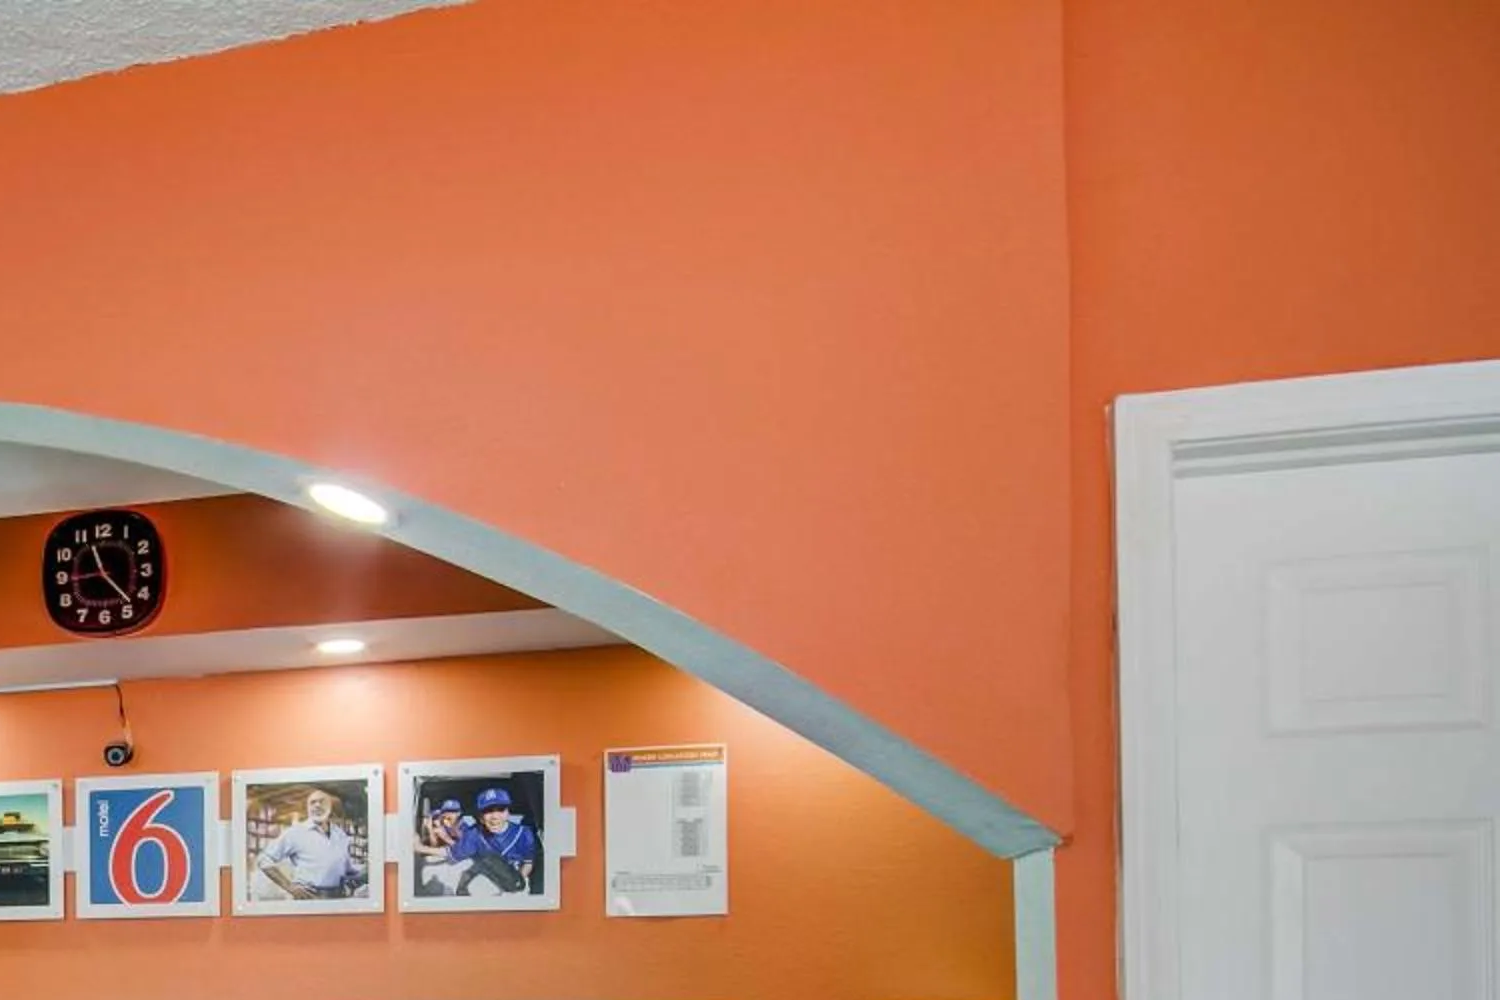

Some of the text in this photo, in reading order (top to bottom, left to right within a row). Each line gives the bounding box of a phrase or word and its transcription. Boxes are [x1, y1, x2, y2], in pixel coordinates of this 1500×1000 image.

[75, 529, 87, 543] 11
[95, 523, 112, 538] 12
[123, 525, 129, 539] 1
[137, 540, 149, 554] 2
[57, 548, 71, 562] 10
[56, 571, 68, 584] 9
[140, 564, 153, 577] 3
[137, 586, 149, 600] 4
[60, 594, 72, 607] 8
[77, 608, 88, 623] 7
[99, 610, 111, 624] 6
[121, 605, 133, 619] 5
[97, 789, 191, 907] motel 6
